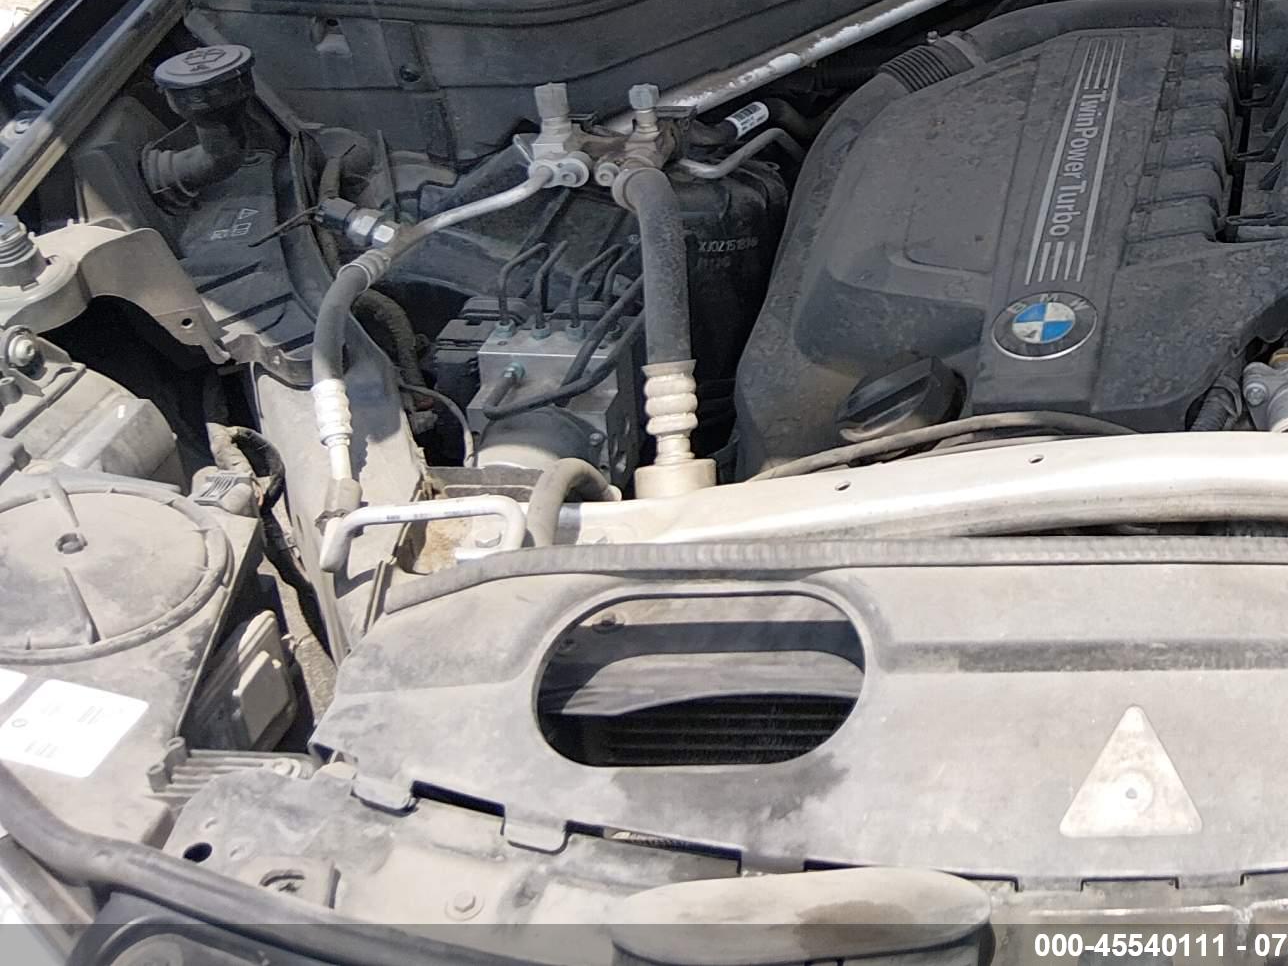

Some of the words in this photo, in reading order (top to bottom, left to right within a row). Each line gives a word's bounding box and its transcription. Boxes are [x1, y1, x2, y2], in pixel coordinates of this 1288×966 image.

[1062, 89, 1107, 177] TwinPower
[1049, 179, 1087, 237] Turbo
[1007, 292, 1091, 315] BMW
